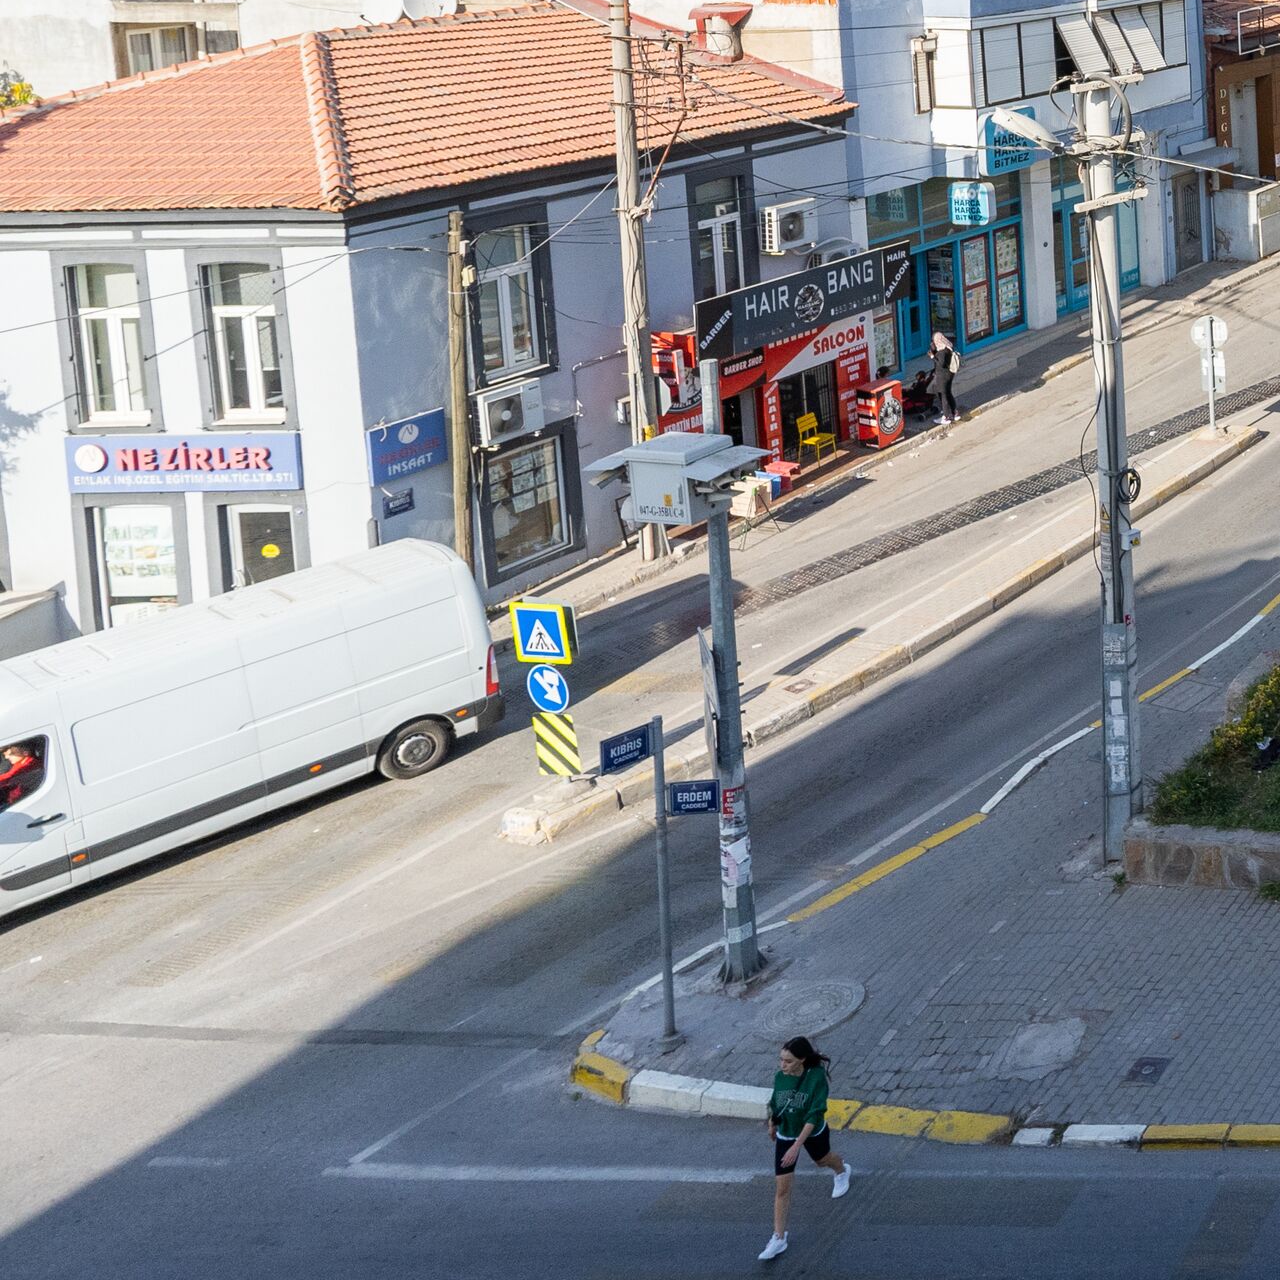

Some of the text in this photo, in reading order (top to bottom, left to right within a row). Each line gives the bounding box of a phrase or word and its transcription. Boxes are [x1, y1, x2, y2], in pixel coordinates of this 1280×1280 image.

[994, 133, 1026, 146] HARC
[953, 199, 981, 208] HARCA
[954, 206, 982, 215] HARCA
[885, 260, 910, 299] SALOON
[744, 259, 874, 320] HAIR BANG
[699, 309, 734, 351] BARBER
[813, 324, 865, 356] SALOON
[723, 359, 748, 376] BARBER
[748, 355, 763, 369] SHOP
[114, 441, 274, 472] NEZİRLER
[74, 475, 111, 486] EMLAK
[609, 737, 643, 759] KIBRIS
[613, 750, 640, 765] CADDESİ
[677, 790, 712, 803] ERDEM
[681, 798, 708, 810] CADDESİ
